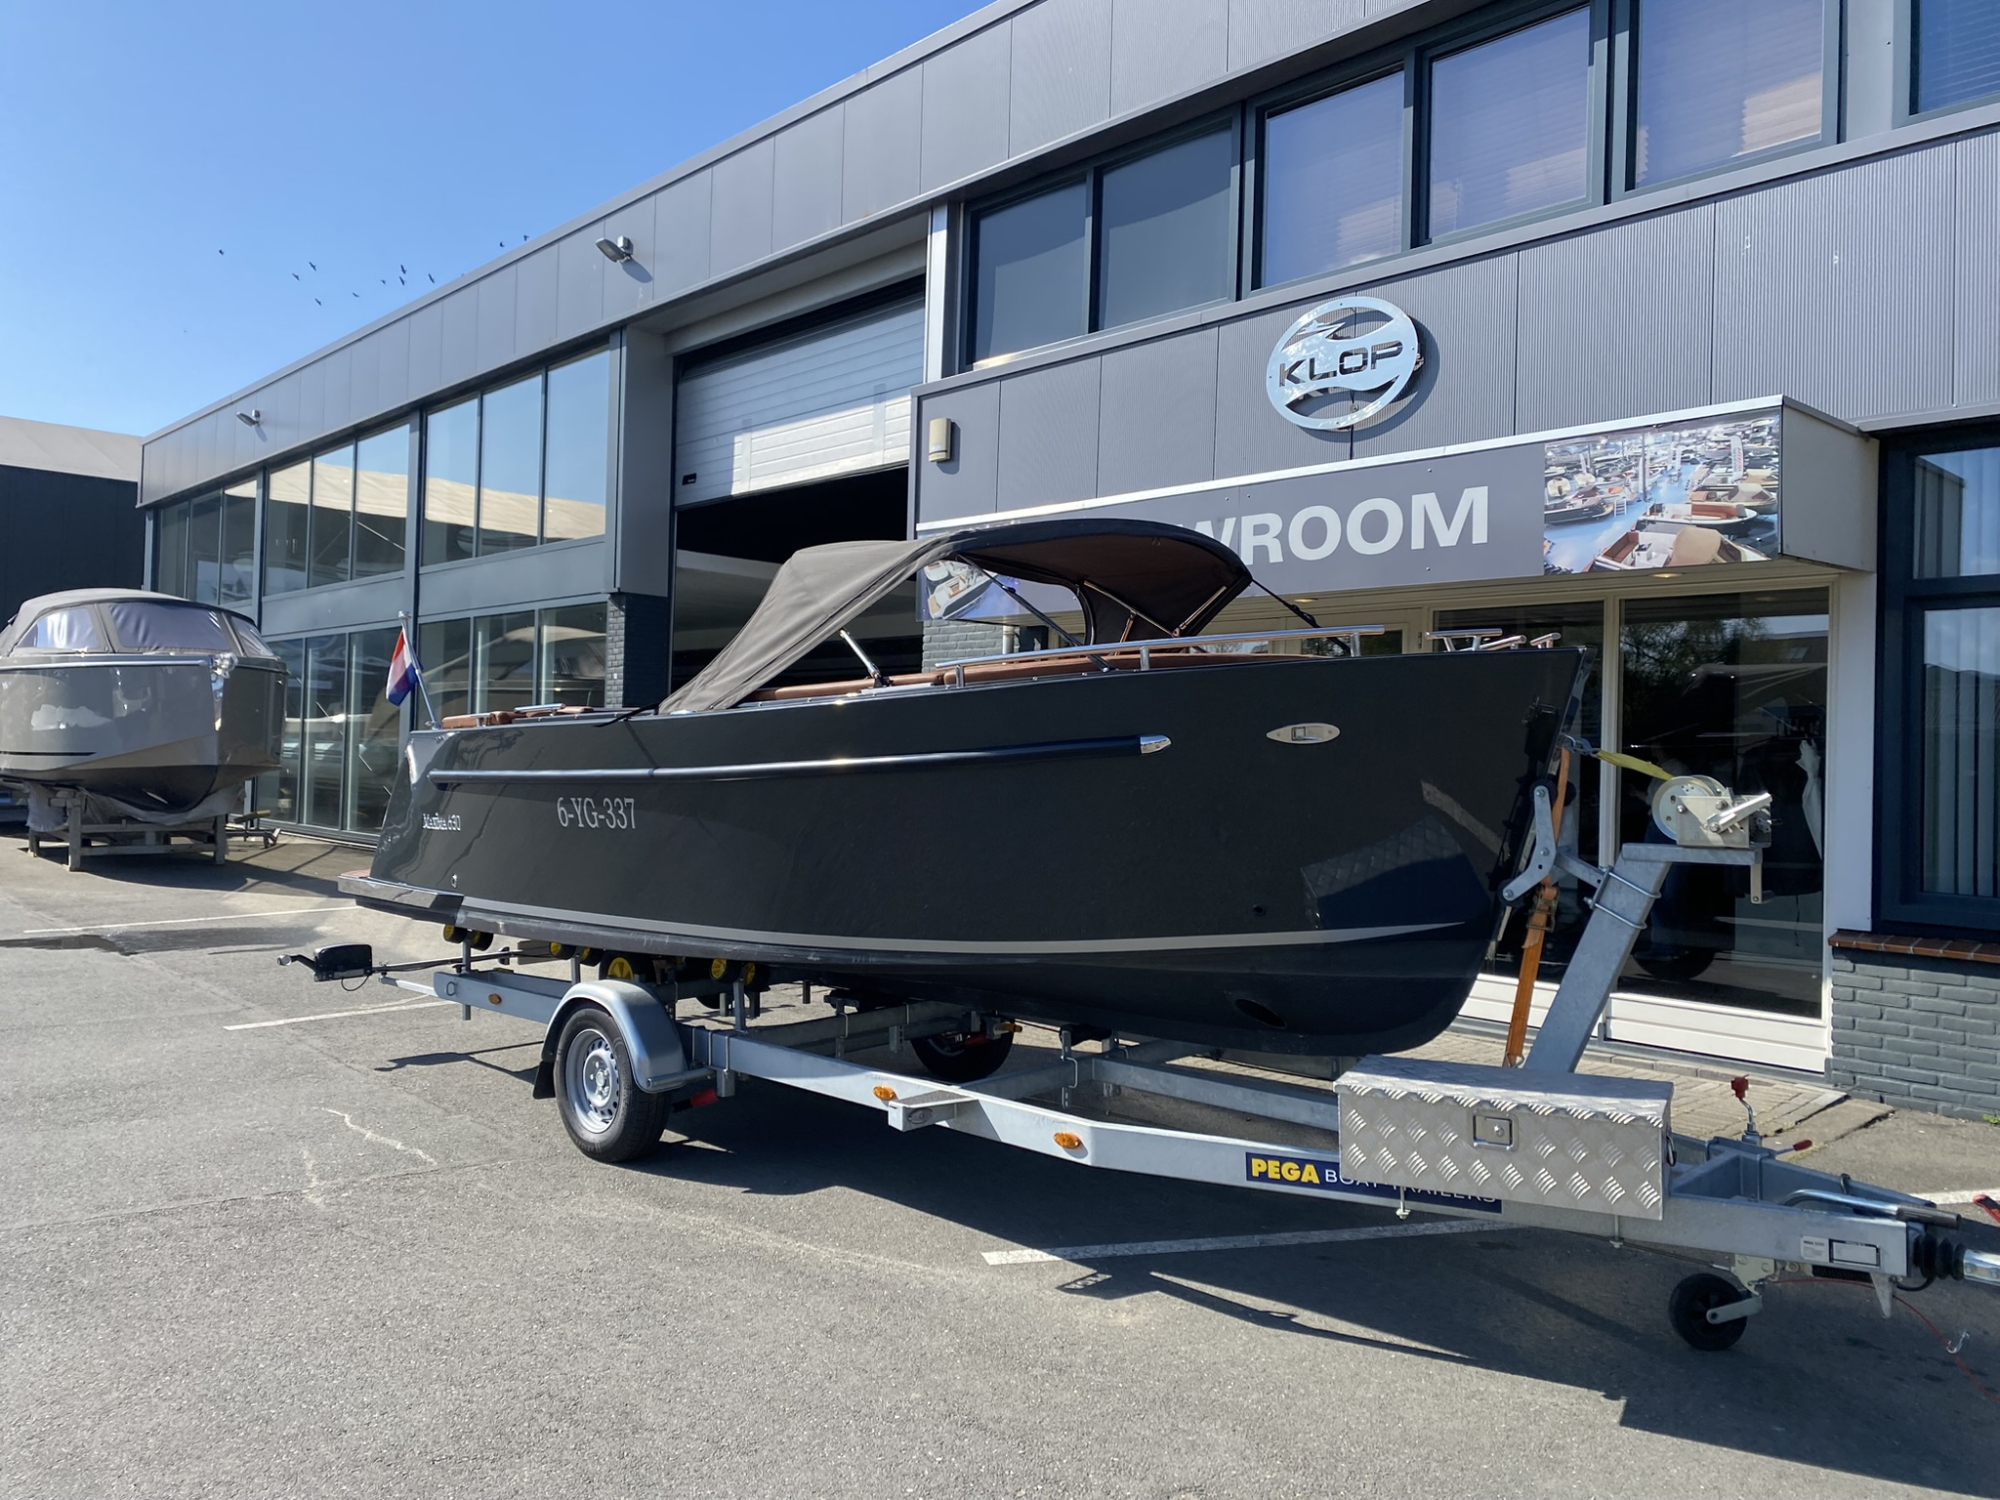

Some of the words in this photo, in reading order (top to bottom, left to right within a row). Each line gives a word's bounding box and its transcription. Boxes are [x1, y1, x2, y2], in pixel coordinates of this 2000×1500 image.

[1279, 340, 1403, 388] KLOP
[556, 796, 637, 830] 6-YG-337
[1251, 1157, 1320, 1185] PEGA
